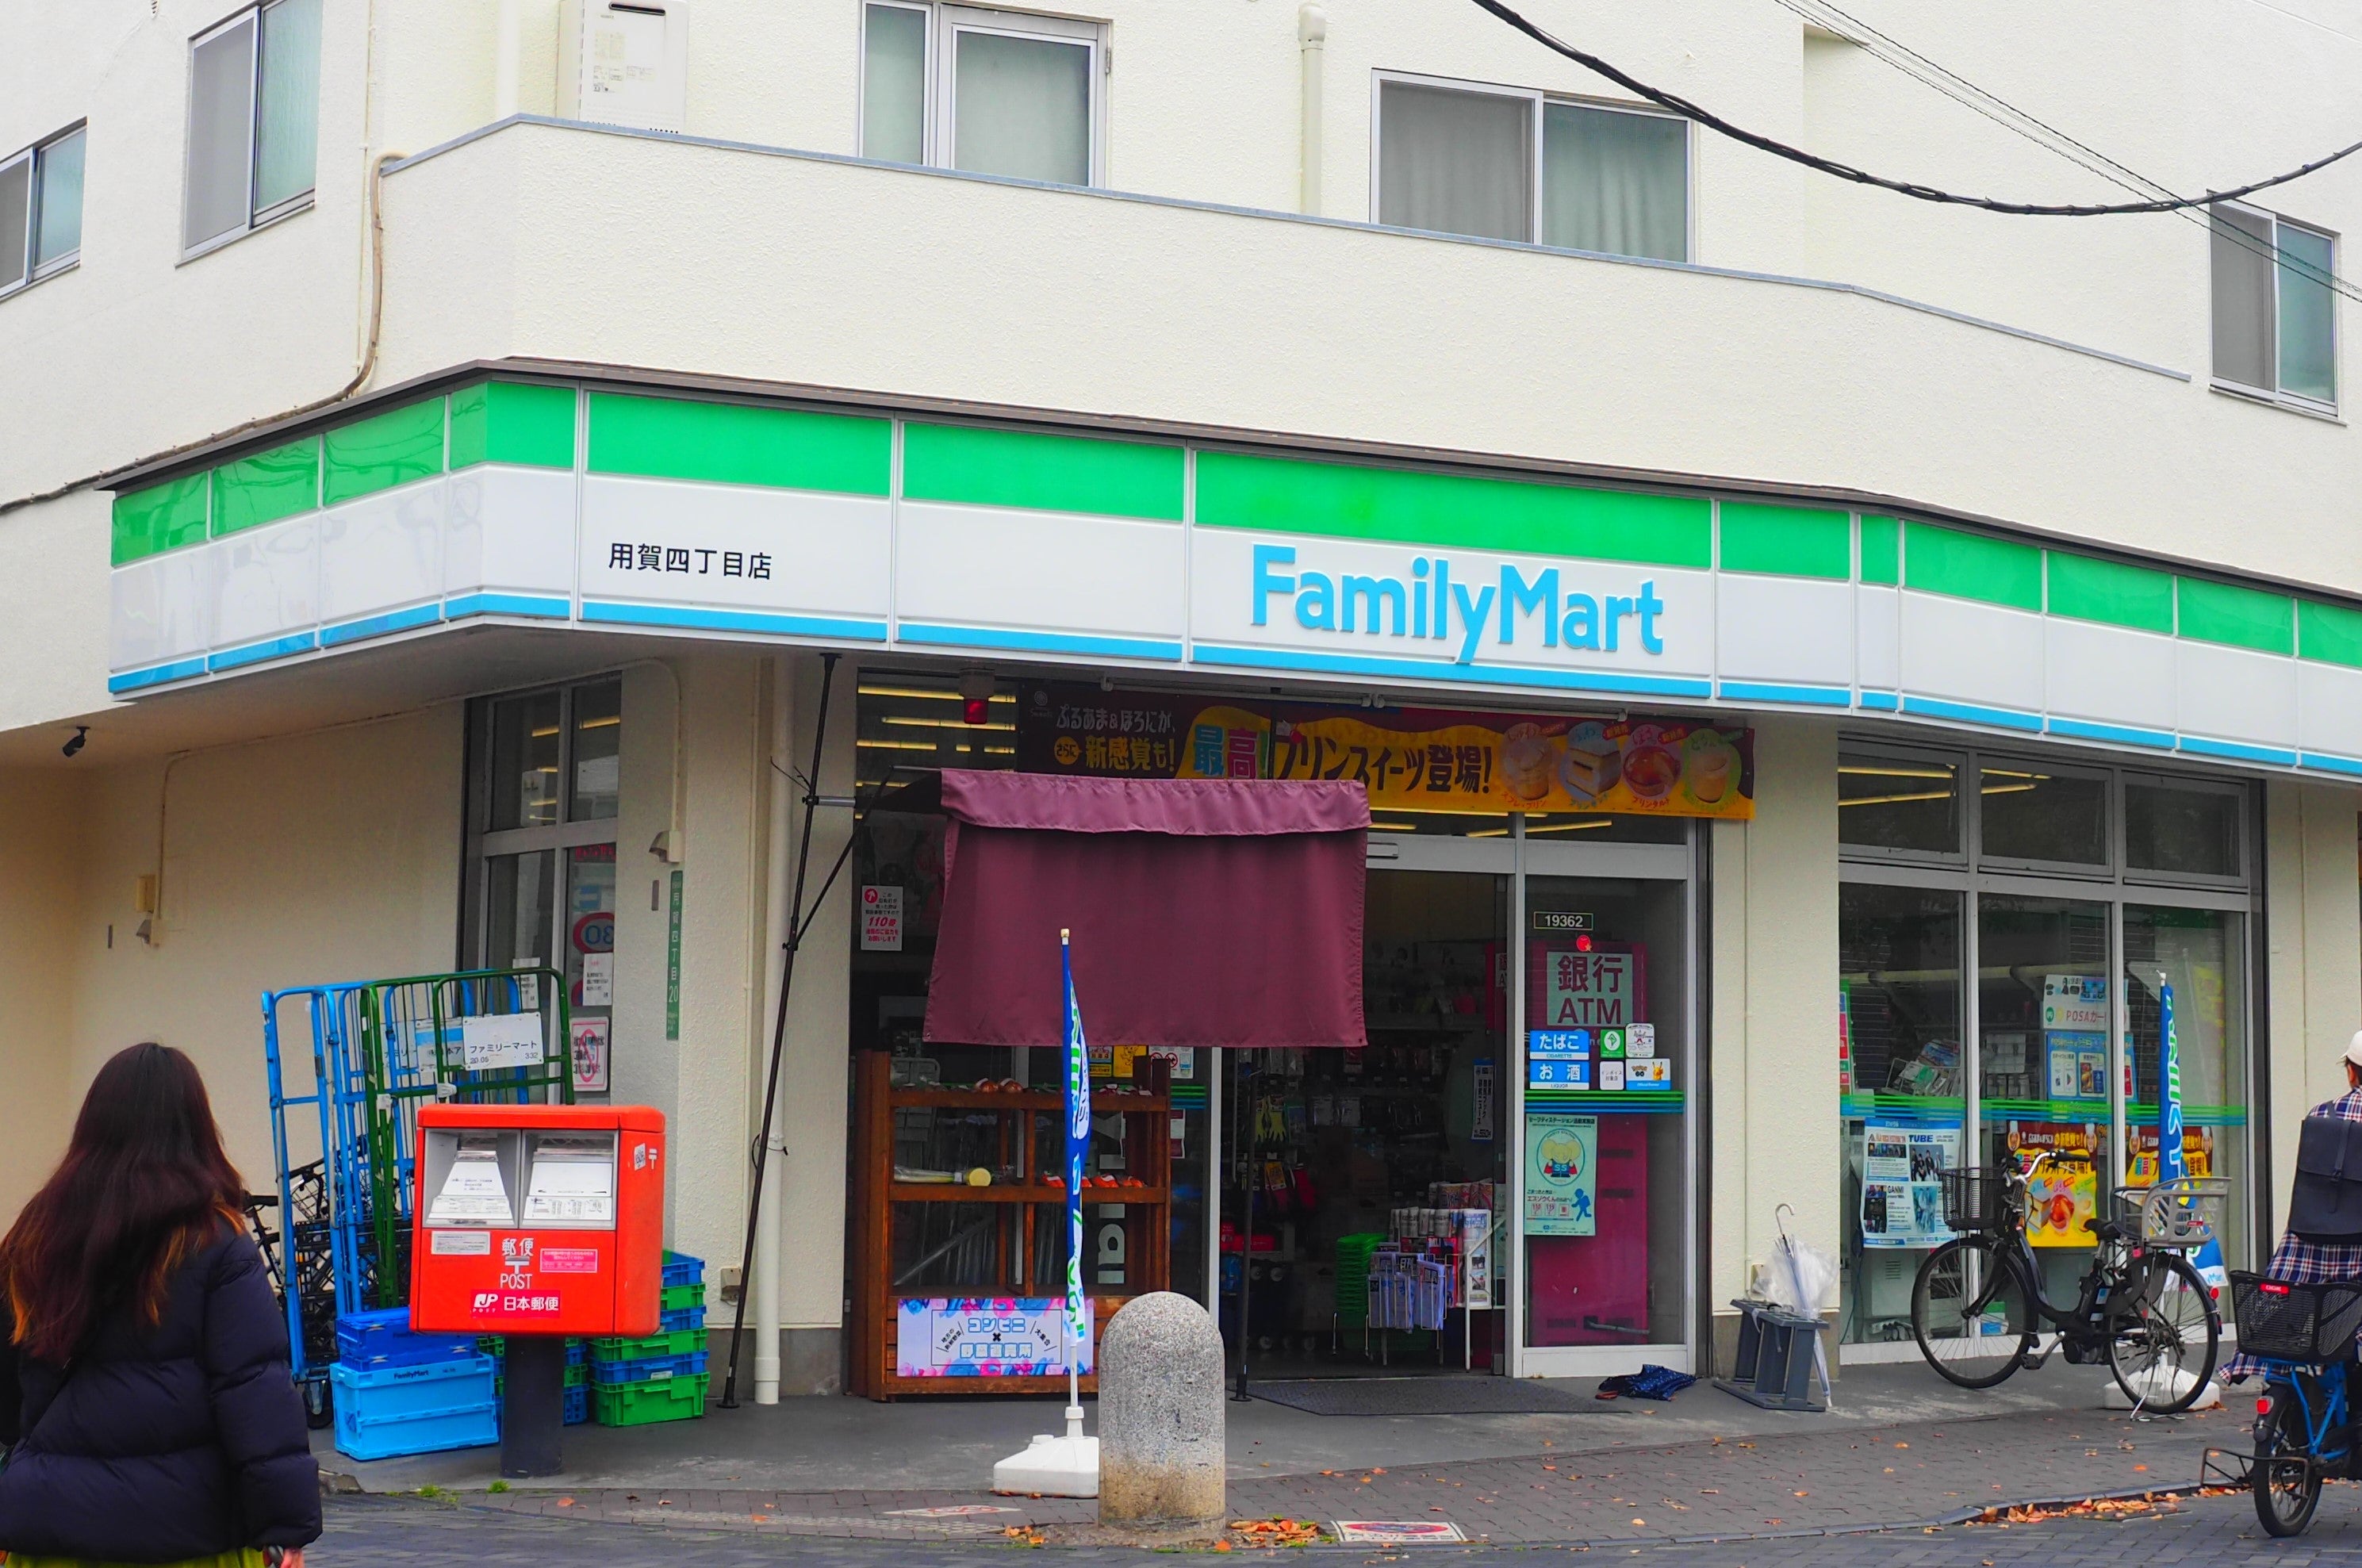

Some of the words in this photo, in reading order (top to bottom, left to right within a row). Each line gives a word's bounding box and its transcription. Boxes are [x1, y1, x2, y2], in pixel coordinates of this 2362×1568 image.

[609, 542, 772, 580] 用賀四丁目店
[1250, 543, 1663, 665] FamilyMart
[1545, 915, 1584, 928] 19362
[1558, 955, 1623, 993] 銀行
[669, 986, 679, 1003] 20
[1557, 998, 1622, 1024] ATM
[470, 1041, 537, 1053] ファミリーマート
[1539, 1033, 1580, 1050] たばこ
[1908, 1134, 1934, 1143] TUBE
[502, 1238, 535, 1256] 郵便
[500, 1273, 533, 1290] POST
[504, 1296, 559, 1311] 日本郵便
[968, 1318, 1026, 1333] コンビニ
